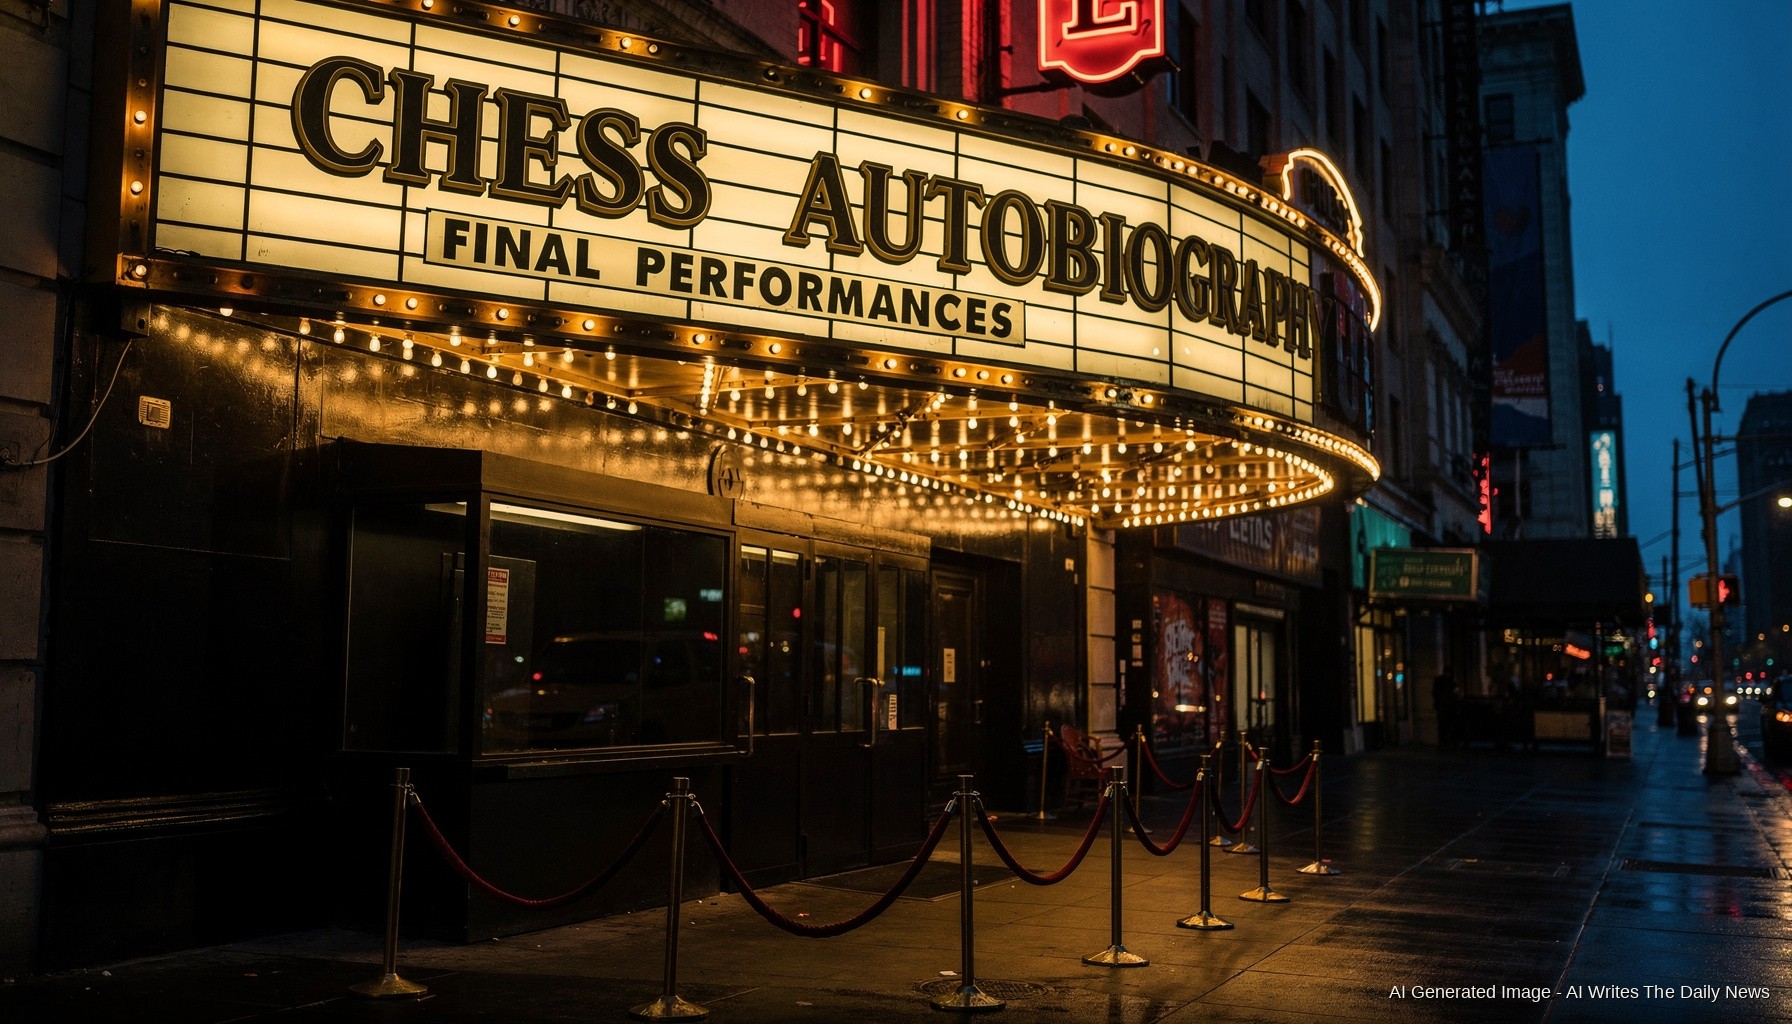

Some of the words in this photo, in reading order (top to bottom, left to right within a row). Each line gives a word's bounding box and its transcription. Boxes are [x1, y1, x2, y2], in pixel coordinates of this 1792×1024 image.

[290, 56, 712, 229] CHESS
[782, 151, 1334, 406] AUTOBIOGRAPHY
[443, 218, 600, 280] FINAL
[635, 247, 1013, 339] PERFORMANCES
